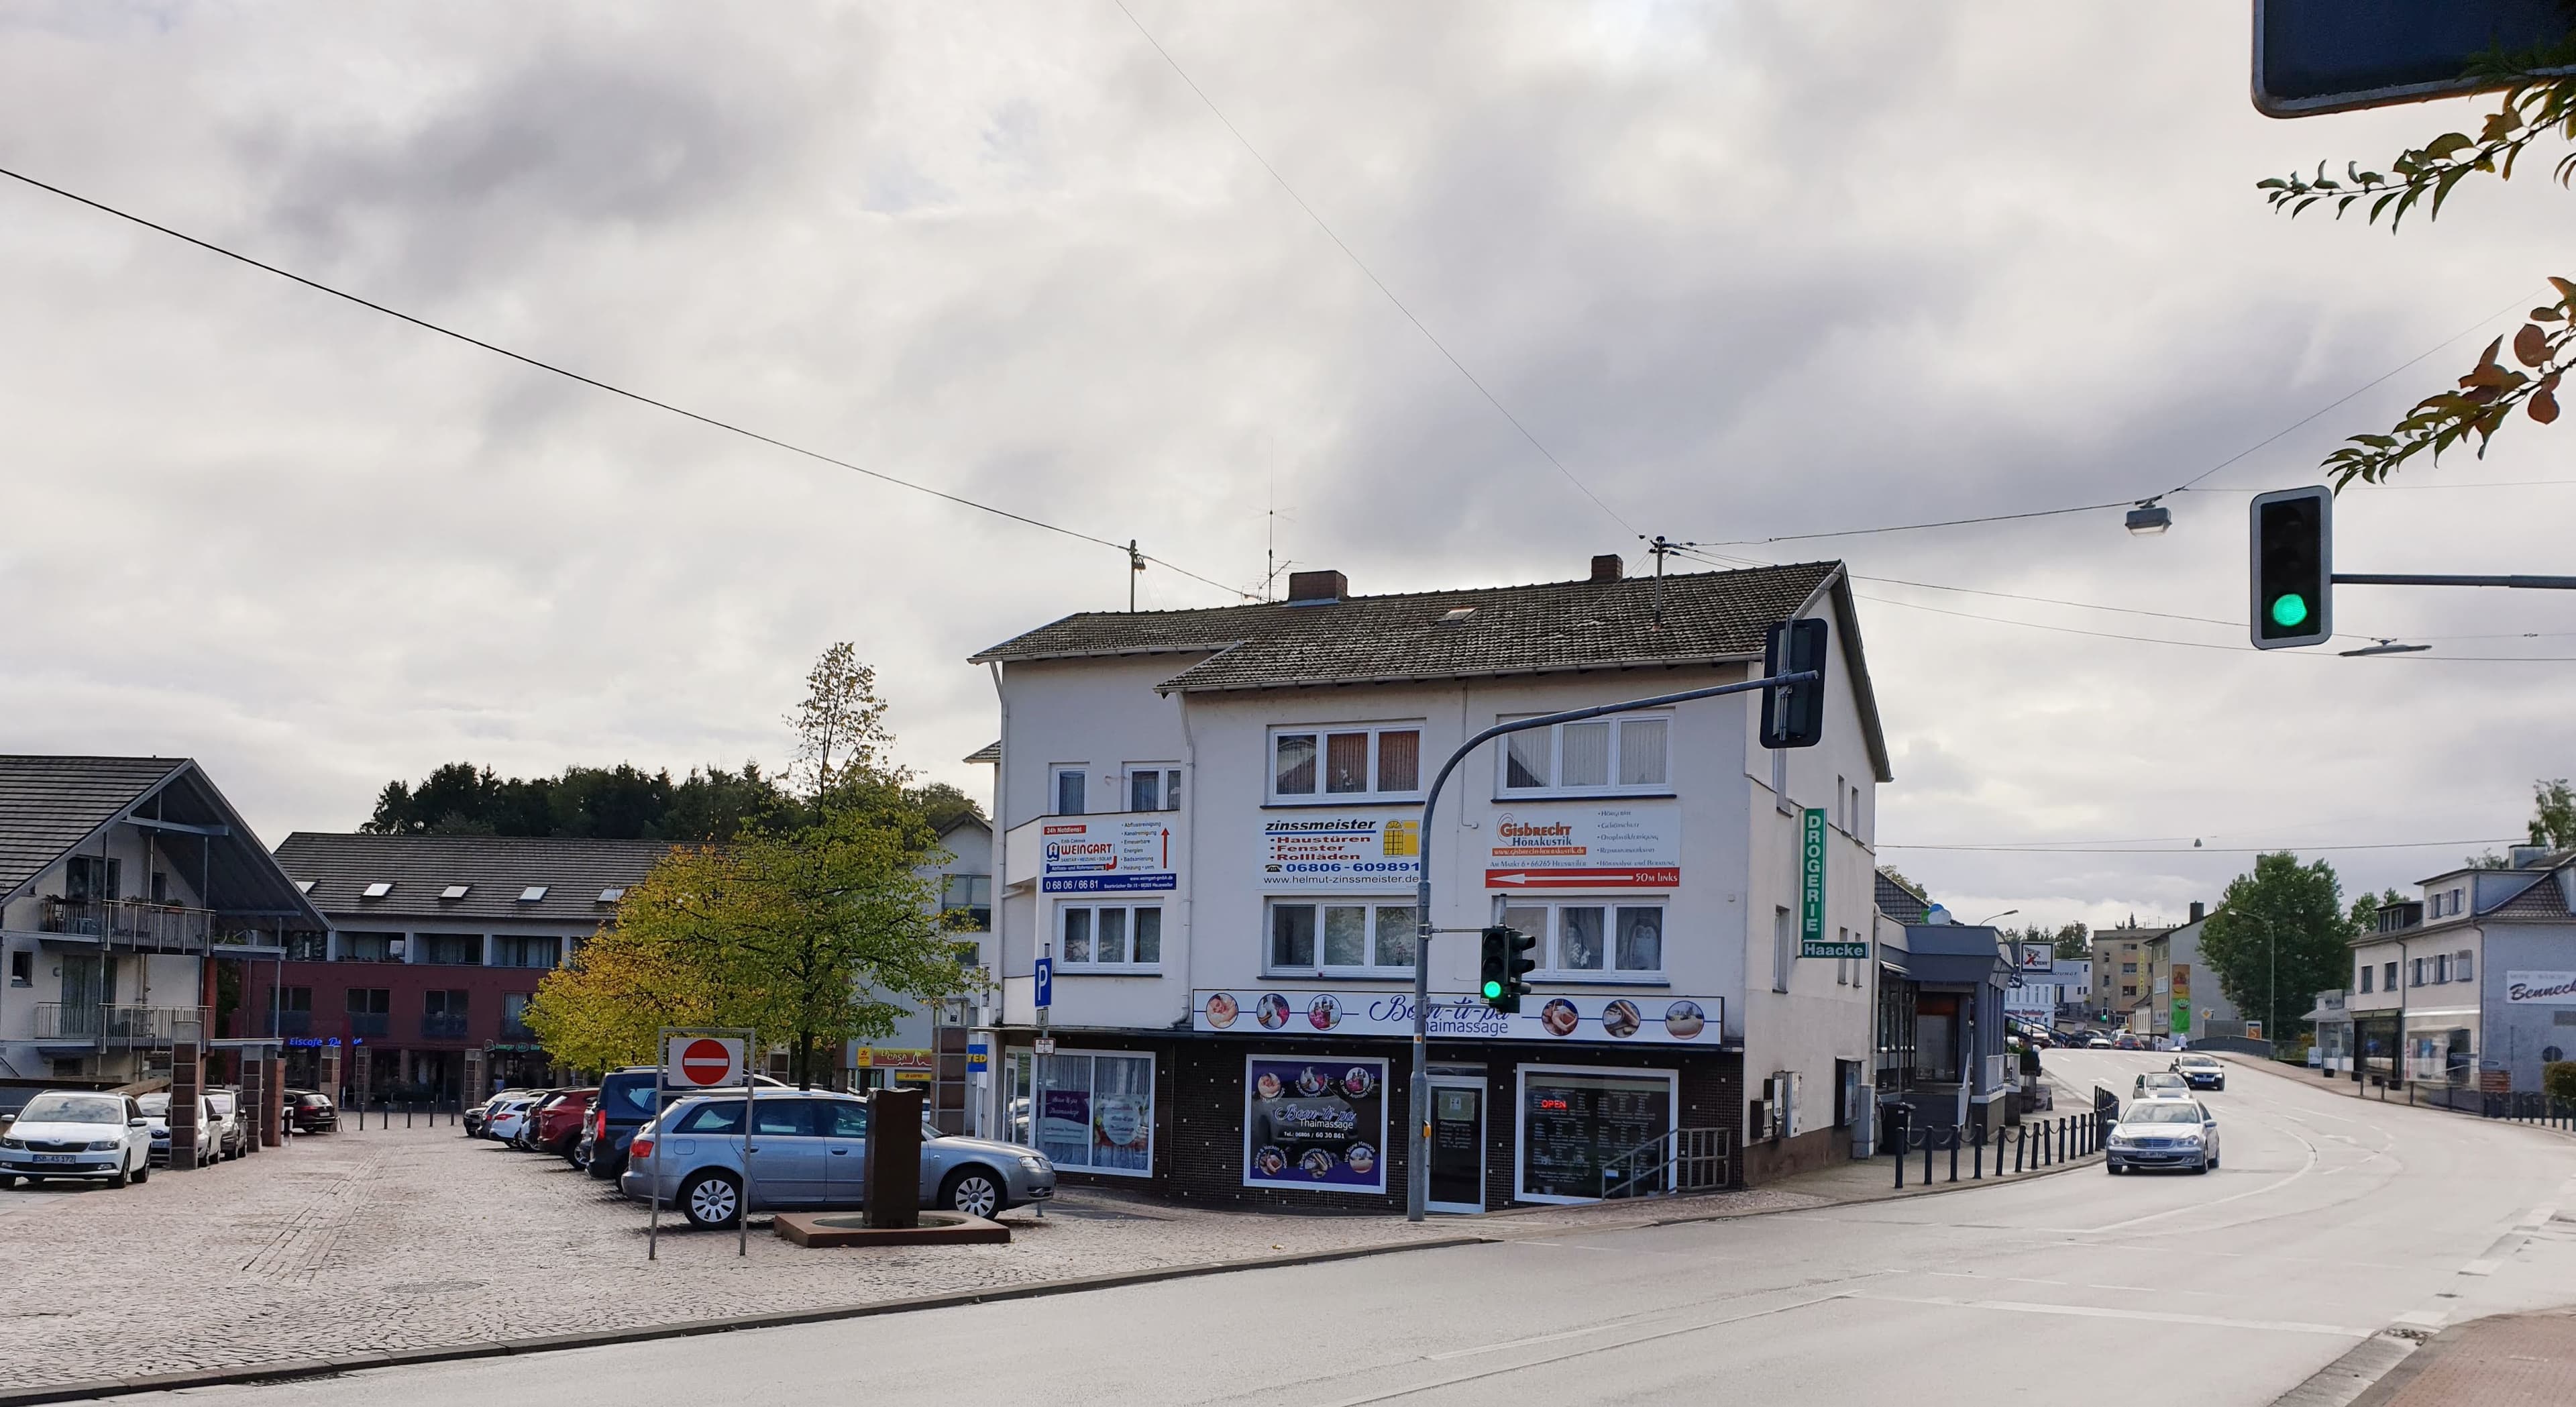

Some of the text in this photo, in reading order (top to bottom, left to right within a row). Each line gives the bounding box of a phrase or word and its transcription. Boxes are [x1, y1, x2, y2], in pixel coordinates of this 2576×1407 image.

[1265, 819, 1376, 831] zinssmeister
[1061, 843, 1112, 855] WEINGART
[1286, 864, 1341, 872] 06806
[1353, 862, 1419, 872] 609891
[1264, 875, 1419, 884] www.helmut-zinssmeister.de
[1658, 872, 1677, 882] links
[1806, 815, 1821, 932] DROGERIE
[1046, 881, 1051, 890] 0
[1053, 880, 1061, 890] 68
[1063, 880, 1073, 890] 06
[1079, 880, 1088, 889] 66
[1089, 880, 1098, 888] 81
[1805, 943, 1864, 956] Haacke
[1038, 965, 1048, 1001] P
[1541, 1100, 1567, 1108] OPEN
[1301, 1118, 1353, 1131] Thaimassage
